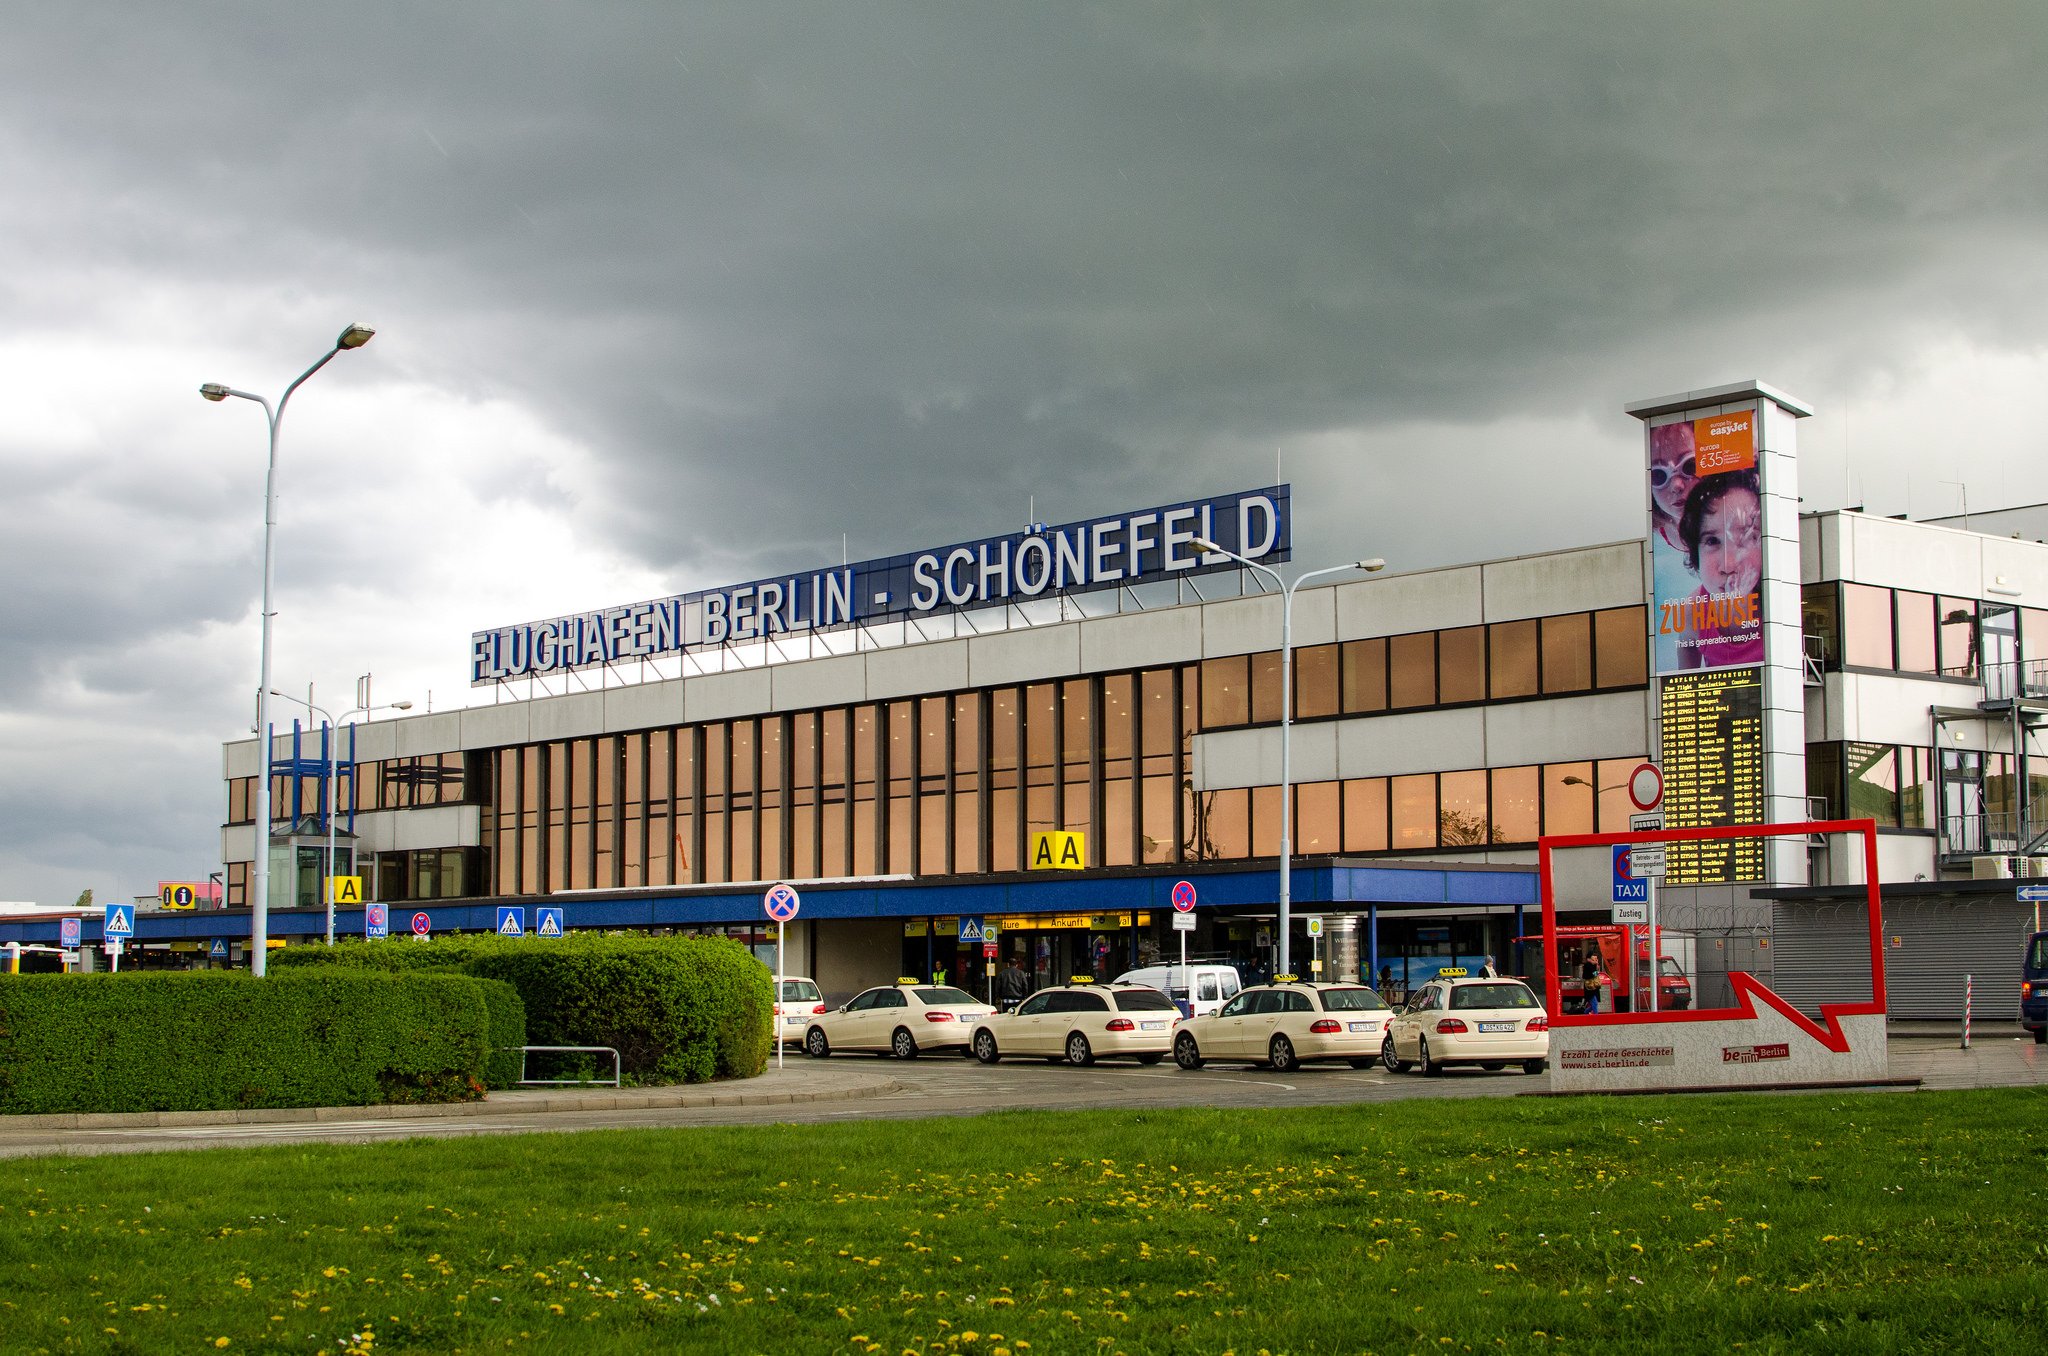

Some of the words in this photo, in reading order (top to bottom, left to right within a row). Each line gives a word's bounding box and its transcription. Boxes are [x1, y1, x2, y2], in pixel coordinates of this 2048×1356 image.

[1711, 422, 1748, 436] easyJet
[1700, 444, 1720, 452] europa
[471, 599, 680, 682] FLUGHAFEN
[703, 568, 856, 645] BERLIN
[911, 494, 1281, 611] SCHÖNEFELD
[1664, 598, 1679, 607] FÜR
[1695, 594, 1708, 604] DIE
[1710, 590, 1743, 602] ÜBERALL
[1660, 602, 1686, 635] ZU
[1692, 593, 1760, 632] HAUSE
[1741, 619, 1760, 630] SIND
[1674, 639, 1688, 649] This
[1689, 639, 1695, 647] is
[1695, 635, 1732, 650] generation
[1708, 670, 1752, 680] DEPARTURE
[1036, 836, 1053, 865] A
[1060, 836, 1080, 865] A
[341, 879, 358, 900] A
[1615, 884, 1645, 898] TAXI
[1619, 908, 1642, 920] Zustieg
[1050, 917, 1084, 928] Ankunft
[369, 926, 386, 935] TAXI
[64, 937, 79, 945] TAXI
[1561, 1050, 1592, 1060] Erzähl
[1594, 1049, 1620, 1059] deine
[1621, 1047, 1674, 1059] Geschichte!
[1723, 1048, 1740, 1062] be
[1760, 1047, 1787, 1059] Berlin
[1561, 1058, 1650, 1070] www.sei.berlin.de
